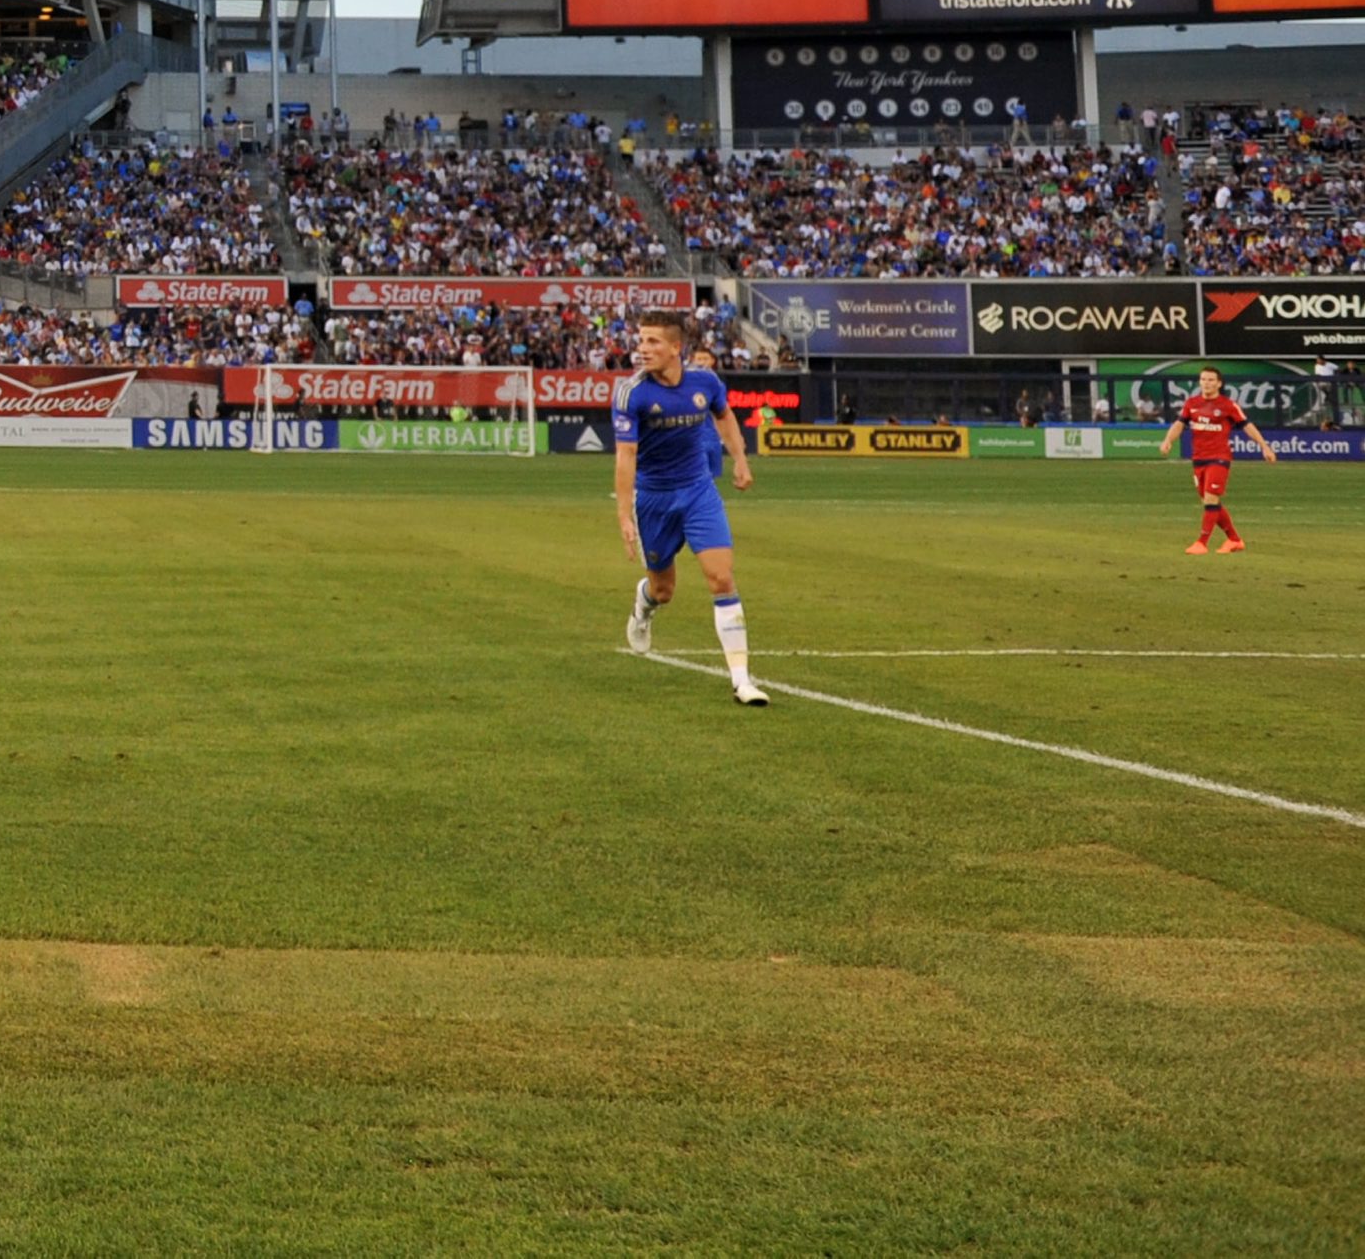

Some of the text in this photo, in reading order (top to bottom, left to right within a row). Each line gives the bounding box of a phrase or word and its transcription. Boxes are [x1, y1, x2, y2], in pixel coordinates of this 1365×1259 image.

[832, 69, 974, 95] New York Yankees
[837, 299, 957, 314] Workmen's Circle
[1259, 294, 1365, 319] YOKOH
[1011, 306, 1189, 330] ROCAWEAR
[837, 324, 957, 338] MultiCare Center
[148, 419, 324, 448] SAMSUNG
[392, 426, 529, 447] HERBALIFE
[770, 432, 849, 447] STANLEY
[875, 433, 954, 448] STANLEY
[1230, 436, 1349, 454] cheeafc.com
